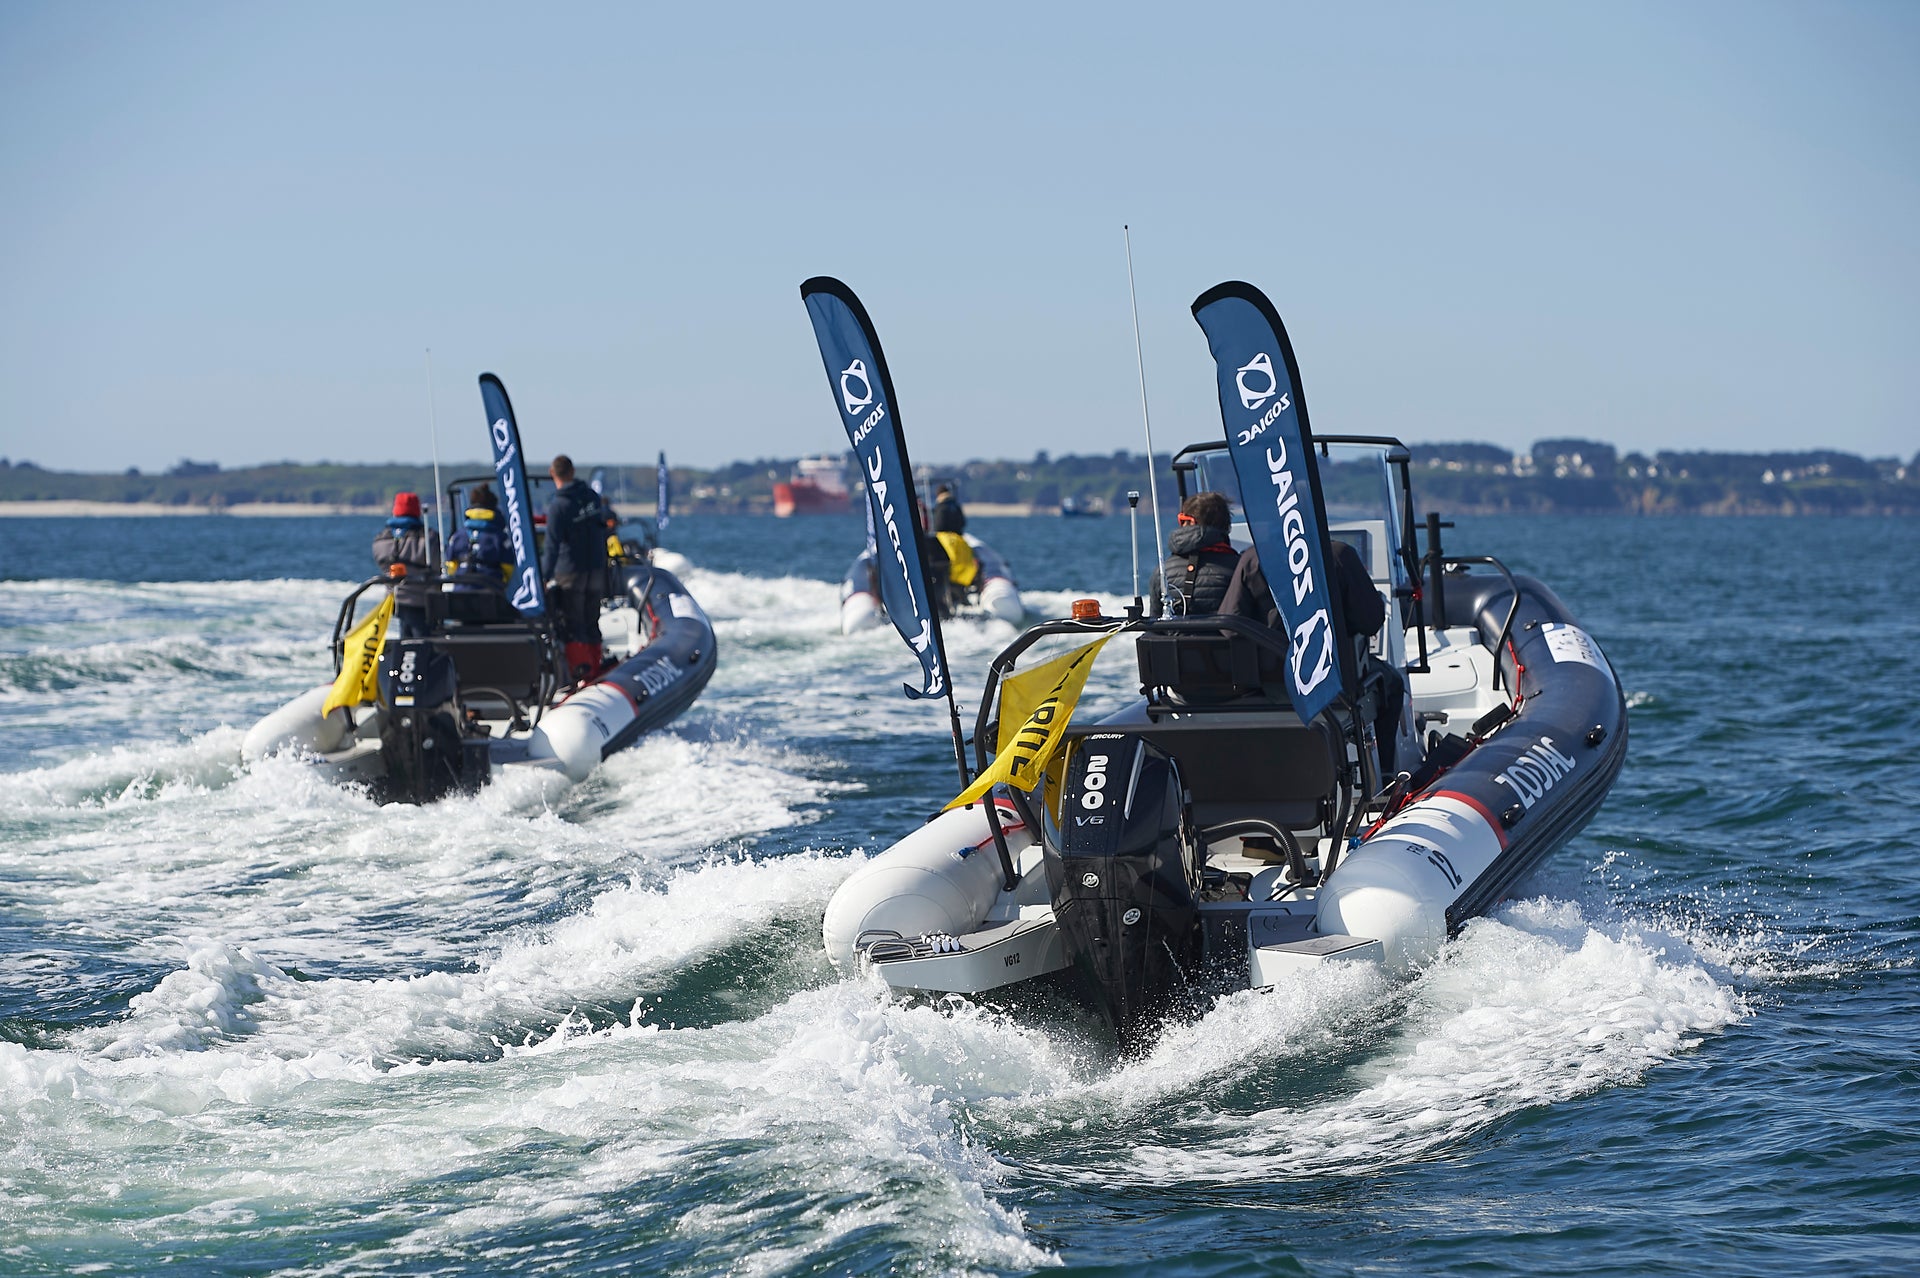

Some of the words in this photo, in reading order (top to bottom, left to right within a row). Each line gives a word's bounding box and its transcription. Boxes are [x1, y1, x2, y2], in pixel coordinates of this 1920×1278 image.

[633, 656, 683, 696] ZODIAC
[1081, 755, 1109, 810] 200
[1494, 736, 1576, 810] ZODIAC
[1075, 815, 1105, 827] V6
[1427, 849, 1463, 890] 12
[1003, 952, 1021, 968] VG12
